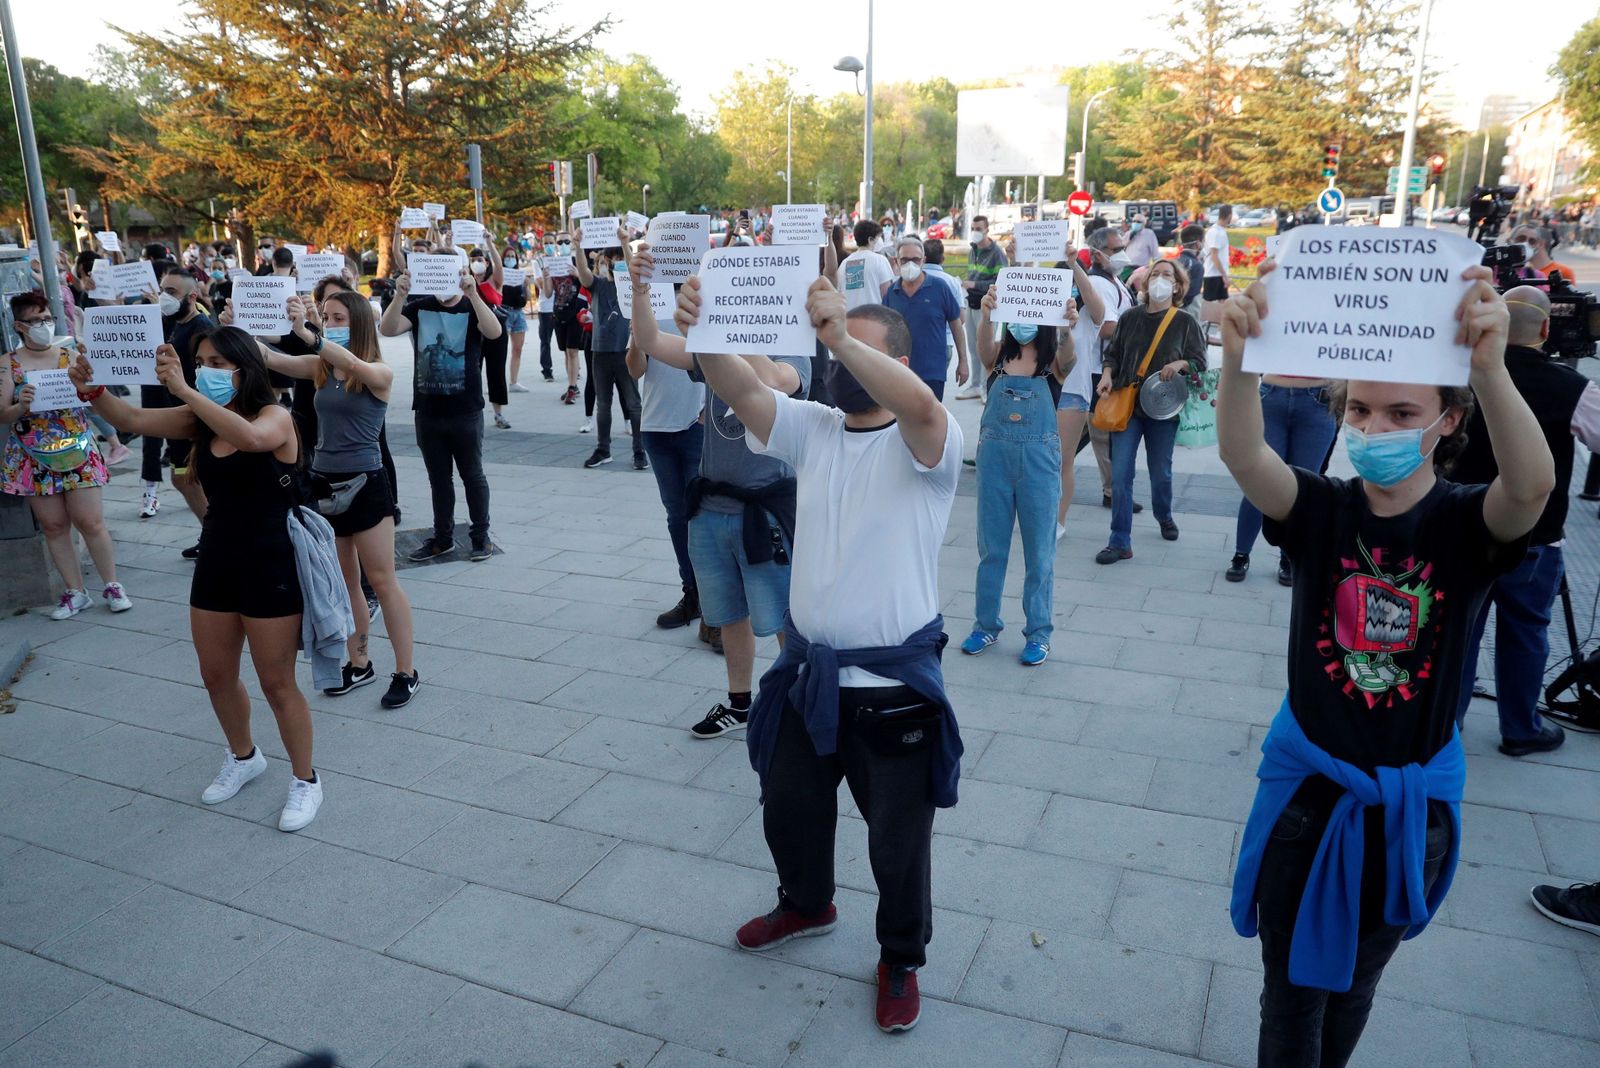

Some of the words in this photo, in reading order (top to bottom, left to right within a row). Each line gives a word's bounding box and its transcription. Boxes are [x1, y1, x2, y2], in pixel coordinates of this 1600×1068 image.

[1300, 240, 1332, 254] LOS
[1339, 239, 1437, 254] FASCISTAS
[707, 256, 750, 269] ¿DÓNDE
[753, 256, 800, 267] ESTABAIS
[1025, 273, 1062, 281] NUESTRA
[1283, 263, 1367, 281] TAMBIÉN
[1373, 267, 1413, 282] SON
[1420, 268, 1448, 283] UN
[732, 276, 775, 286] CUANDO
[715, 296, 783, 306] RECORTABAN
[786, 296, 792, 305] Y
[1001, 296, 1028, 306] JUEGA,
[1031, 298, 1062, 307] FACHAS
[1334, 294, 1389, 310] VIRUS
[1017, 310, 1043, 318] FUERA
[92, 316, 104, 324] CON
[107, 315, 146, 324] NUESTRA
[708, 315, 782, 324] PRIVATIZABAN
[786, 315, 798, 325] LA
[1284, 321, 1328, 335] ¡VIVA
[1334, 323, 1352, 335] LA
[1358, 324, 1435, 339] SANIDAD
[93, 332, 118, 341] SALUD
[120, 333, 133, 341] NO
[136, 332, 146, 341] SE
[726, 333, 778, 344] SANIDAD?
[91, 350, 119, 360] JUEGA,
[121, 350, 154, 358] FACHAS
[1317, 344, 1393, 362] PÚBLICA!
[112, 366, 140, 375] FUERA
